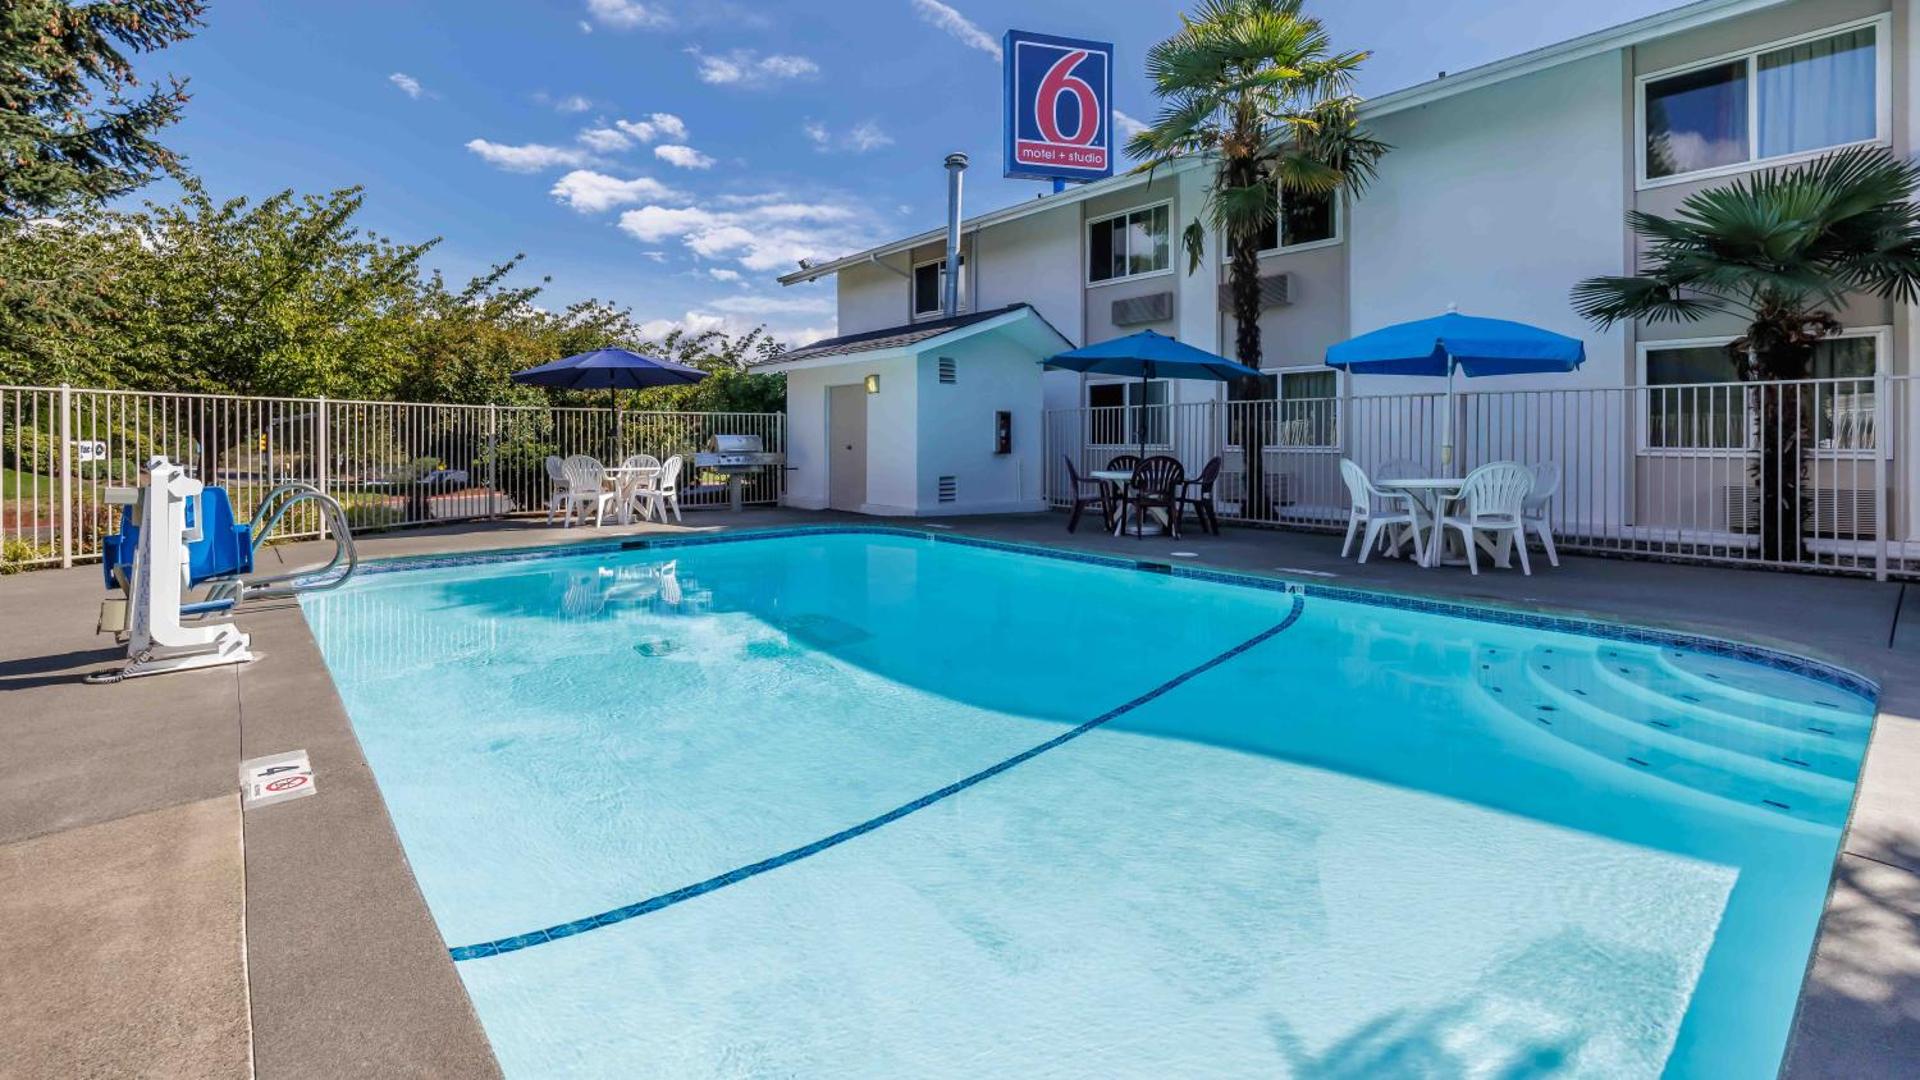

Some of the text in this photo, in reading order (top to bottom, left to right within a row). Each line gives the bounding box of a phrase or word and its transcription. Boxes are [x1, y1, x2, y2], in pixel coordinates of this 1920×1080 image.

[1034, 49, 1100, 147] 6
[1023, 148, 1056, 160] motel
[1068, 151, 1103, 164] studio
